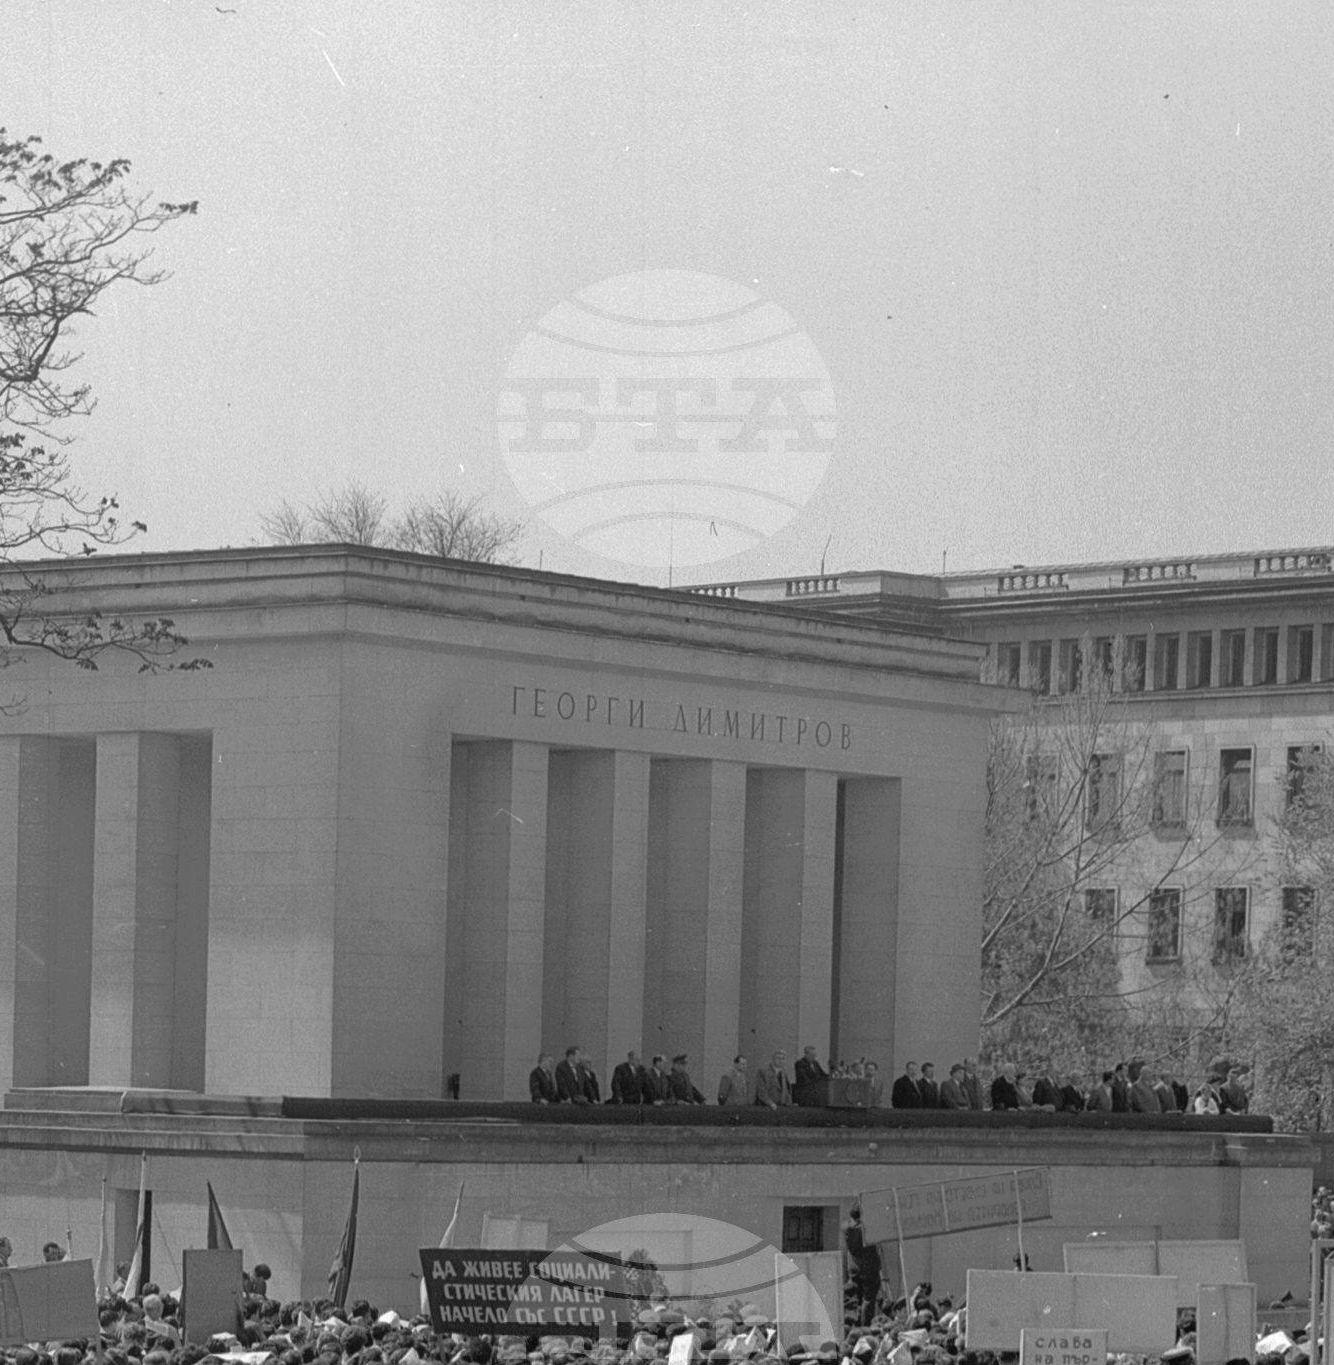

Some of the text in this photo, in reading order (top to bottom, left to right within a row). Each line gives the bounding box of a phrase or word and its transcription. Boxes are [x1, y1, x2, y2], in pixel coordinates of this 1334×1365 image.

[512, 685, 851, 750] ГЕОРГИ ДИМИТРОВ
[432, 1260, 616, 1281] ДА ЖИВЕЕ СОЦИАЛИ-
[443, 1283, 605, 1303] СТИЧЕСКИЯ ЛАГЕР
[439, 1305, 507, 1323] НАЧЕЛО
[554, 1307, 605, 1325] СССР
